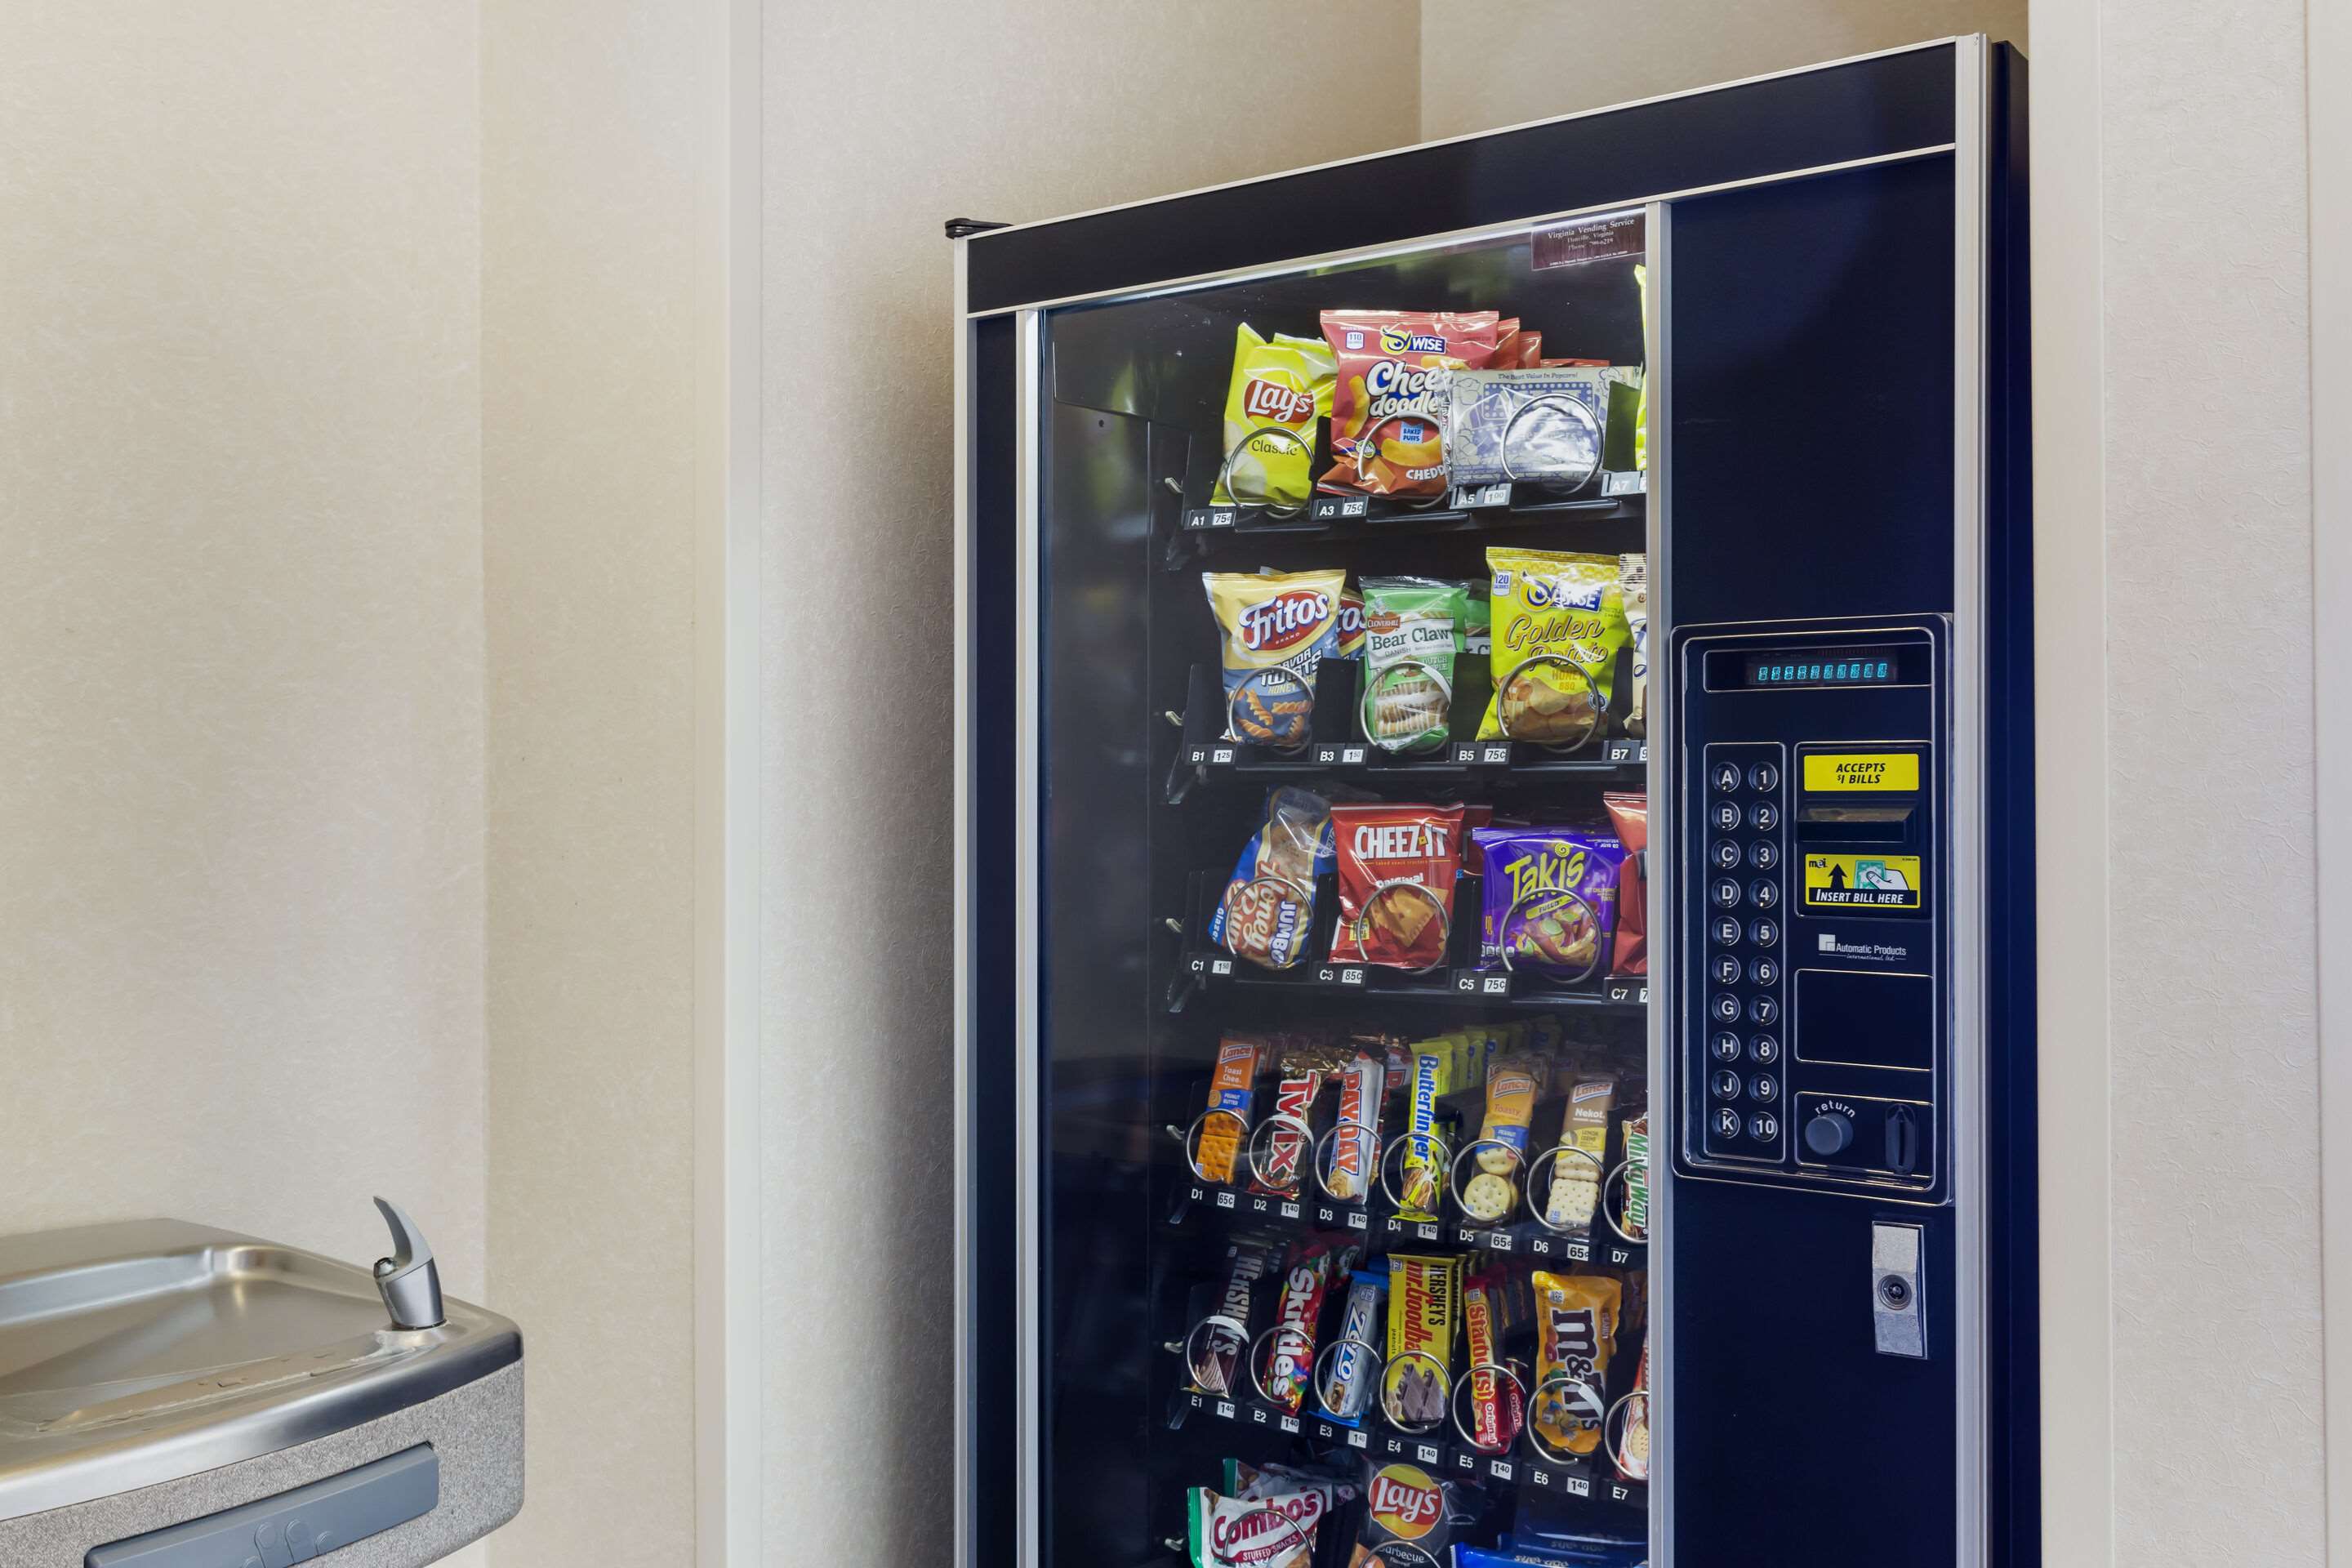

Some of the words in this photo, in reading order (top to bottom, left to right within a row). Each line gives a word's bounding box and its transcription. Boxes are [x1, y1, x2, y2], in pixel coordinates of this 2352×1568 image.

[1548, 229, 1575, 239] Virginia
[1578, 224, 1607, 234] Vending
[1610, 218, 1634, 229] Service
[1412, 336, 1444, 352] WISE
[1247, 381, 1312, 423] Lay's
[1370, 392, 1438, 417] doodle
[1251, 439, 1298, 457] Clasic
[1405, 465, 1446, 480] CHEDD
[1459, 493, 1474, 505] A5
[1320, 506, 1334, 516] A3
[1346, 503, 1362, 513] 75¢
[1191, 516, 1205, 526] A1
[1215, 514, 1232, 523] 75¢
[1495, 574, 1509, 585] 120
[1238, 591, 1330, 650] Fritos
[1367, 619, 1399, 628] CLOVERHILL
[1371, 633, 1407, 650] Bear
[1411, 627, 1450, 644] Claw
[1503, 613, 1606, 651] Golden
[1384, 647, 1411, 657] DANISH
[1192, 751, 1205, 762] B1
[1320, 751, 1334, 762] B3
[1459, 751, 1474, 761] B5
[1488, 749, 1506, 760] 75¢
[1610, 749, 1628, 760] B7
[1836, 763, 1886, 773] ACCEPTS
[1722, 770, 1733, 785] A
[1760, 770, 1767, 784] 1
[1838, 774, 1845, 784] $1
[1849, 774, 1881, 784] BILLS
[1722, 809, 1733, 822] B
[1760, 809, 1769, 822] 2
[1722, 847, 1734, 862] C
[1760, 848, 1770, 862] 3
[1722, 886, 1734, 900] D
[1760, 887, 1770, 900] 4
[1815, 889, 1851, 902] INSERT
[1853, 893, 1875, 903] BILL
[1878, 893, 1904, 904] HERE
[1242, 861, 1286, 951] Honey
[1723, 924, 1733, 938] E
[1760, 926, 1770, 939] 5
[1836, 942, 1872, 954] Automatic
[1873, 945, 1907, 956] Products
[1191, 961, 1204, 971] C1
[1723, 963, 1733, 976] F
[1760, 964, 1770, 978] 6
[1320, 970, 1334, 981] C3
[1344, 970, 1362, 981] 85¢
[1459, 979, 1475, 990] C5
[1487, 980, 1506, 990] 75¢
[1610, 989, 1628, 1000] C7
[1722, 1001, 1734, 1014] G
[1760, 1004, 1770, 1017] 7
[1722, 1039, 1734, 1053] H
[1760, 1042, 1770, 1057] 8
[1723, 1078, 1732, 1093] J
[1760, 1080, 1771, 1094] 9
[1413, 1054, 1440, 1163] Butterfinger
[1815, 1101, 1856, 1118] return
[1336, 1071, 1362, 1176] PAYDAY
[1722, 1116, 1734, 1130] K
[1757, 1120, 1775, 1134] 10
[1191, 1189, 1203, 1200] D1
[1218, 1195, 1234, 1205] 65¢
[1254, 1200, 1267, 1210] D2
[1320, 1209, 1333, 1221] D3
[1388, 1220, 1401, 1232] D4
[1459, 1229, 1474, 1241] D5
[1534, 1241, 1549, 1253] D6
[1612, 1250, 1628, 1263] D7
[1428, 1264, 1447, 1326] HERSHEY'S
[1272, 1266, 1316, 1397] Skittles
[1468, 1304, 1495, 1401] Starburst
[1191, 1396, 1203, 1408] E1
[1254, 1410, 1267, 1423] E2
[1484, 1402, 1498, 1444] Original
[1320, 1425, 1333, 1437] E3
[1388, 1441, 1401, 1454] E4
[1459, 1455, 1473, 1468] E5
[1534, 1471, 1549, 1486] E6
[1374, 1477, 1439, 1523] Lay's
[1612, 1486, 1628, 1500] E7
[1214, 1493, 1318, 1549] Combos
[1242, 1548, 1272, 1561] STUFFED
[1379, 1545, 1425, 1563] arbecue
